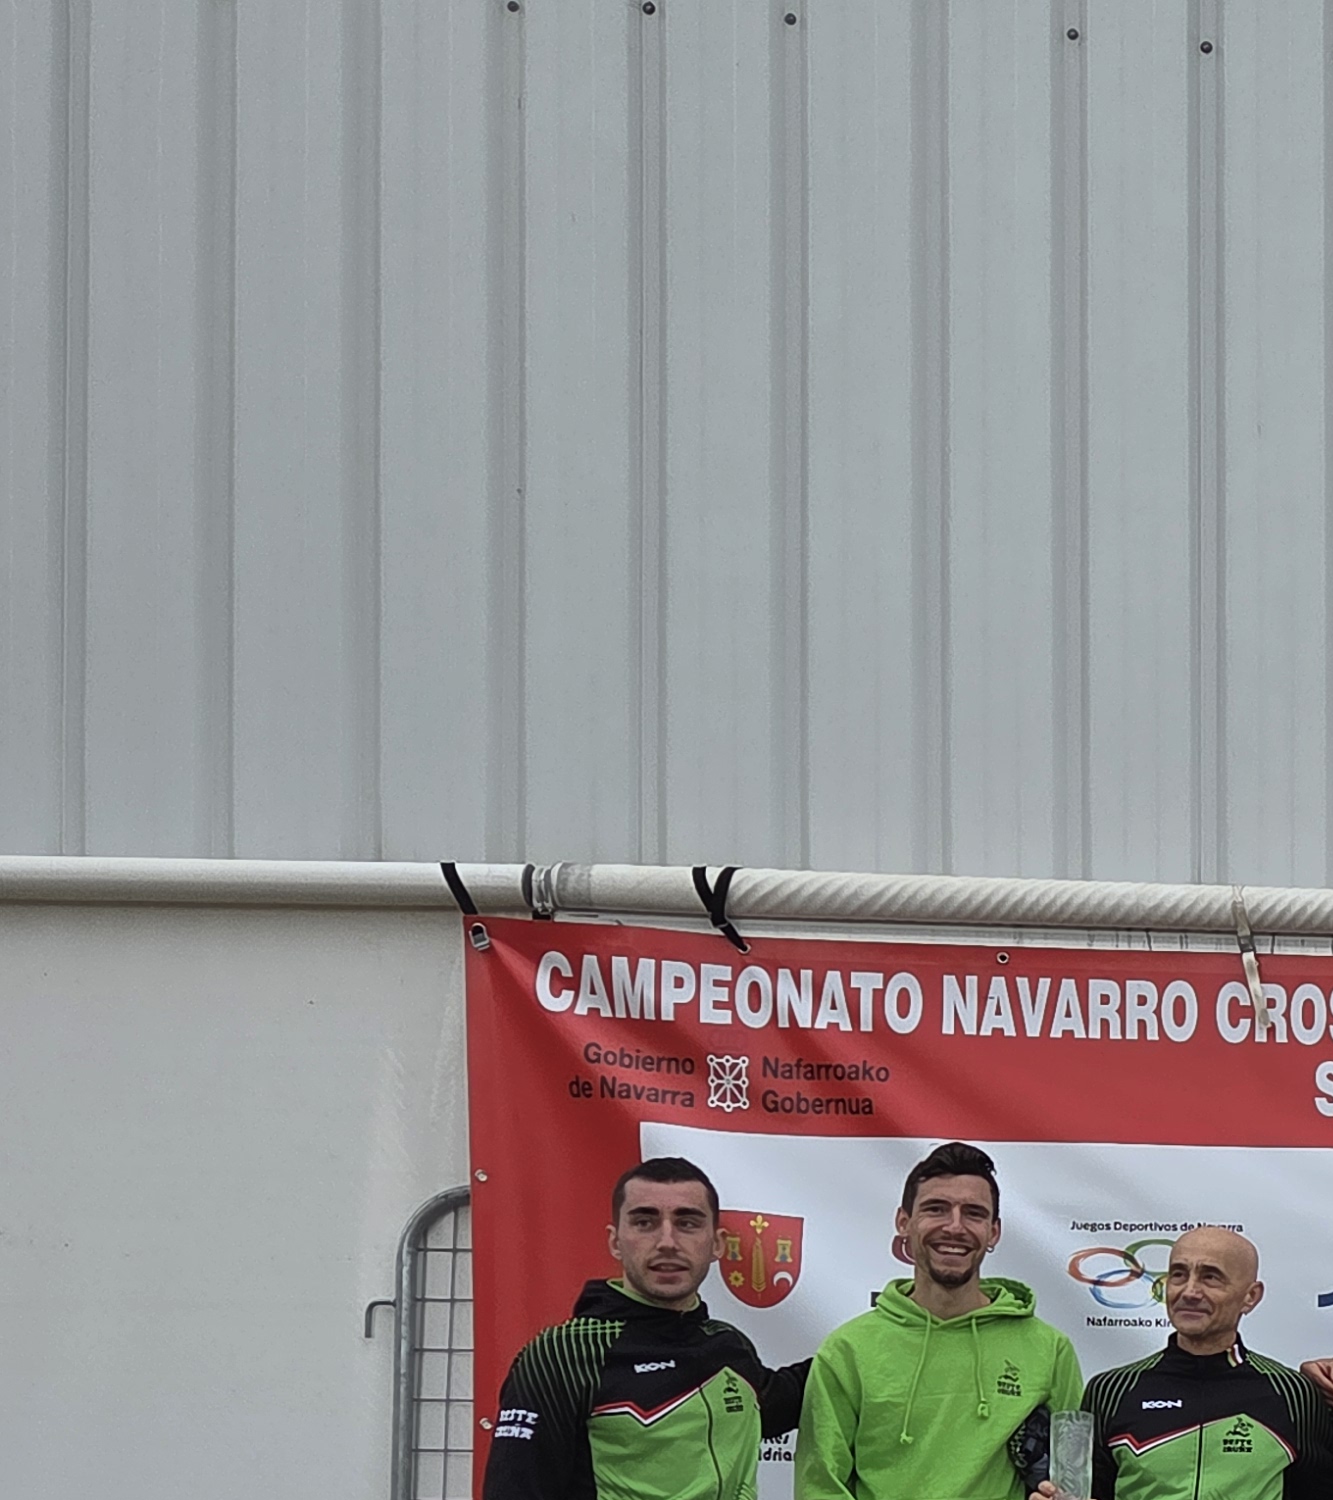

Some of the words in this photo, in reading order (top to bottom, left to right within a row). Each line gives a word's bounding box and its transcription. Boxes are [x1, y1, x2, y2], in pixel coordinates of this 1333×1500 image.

[535, 951, 923, 1035] CAMPEONATO
[941, 974, 1199, 1042] NAVARRO
[583, 1042, 695, 1075] Gobierno
[762, 1055, 890, 1083] Nafarroako
[568, 1075, 593, 1098] de
[600, 1075, 695, 1108] Navarra
[762, 1089, 874, 1116] Gobernua
[1070, 1221, 1112, 1233] Juegos
[1113, 1221, 1178, 1233] Deportivos
[1086, 1316, 1151, 1328] Nafarroako
